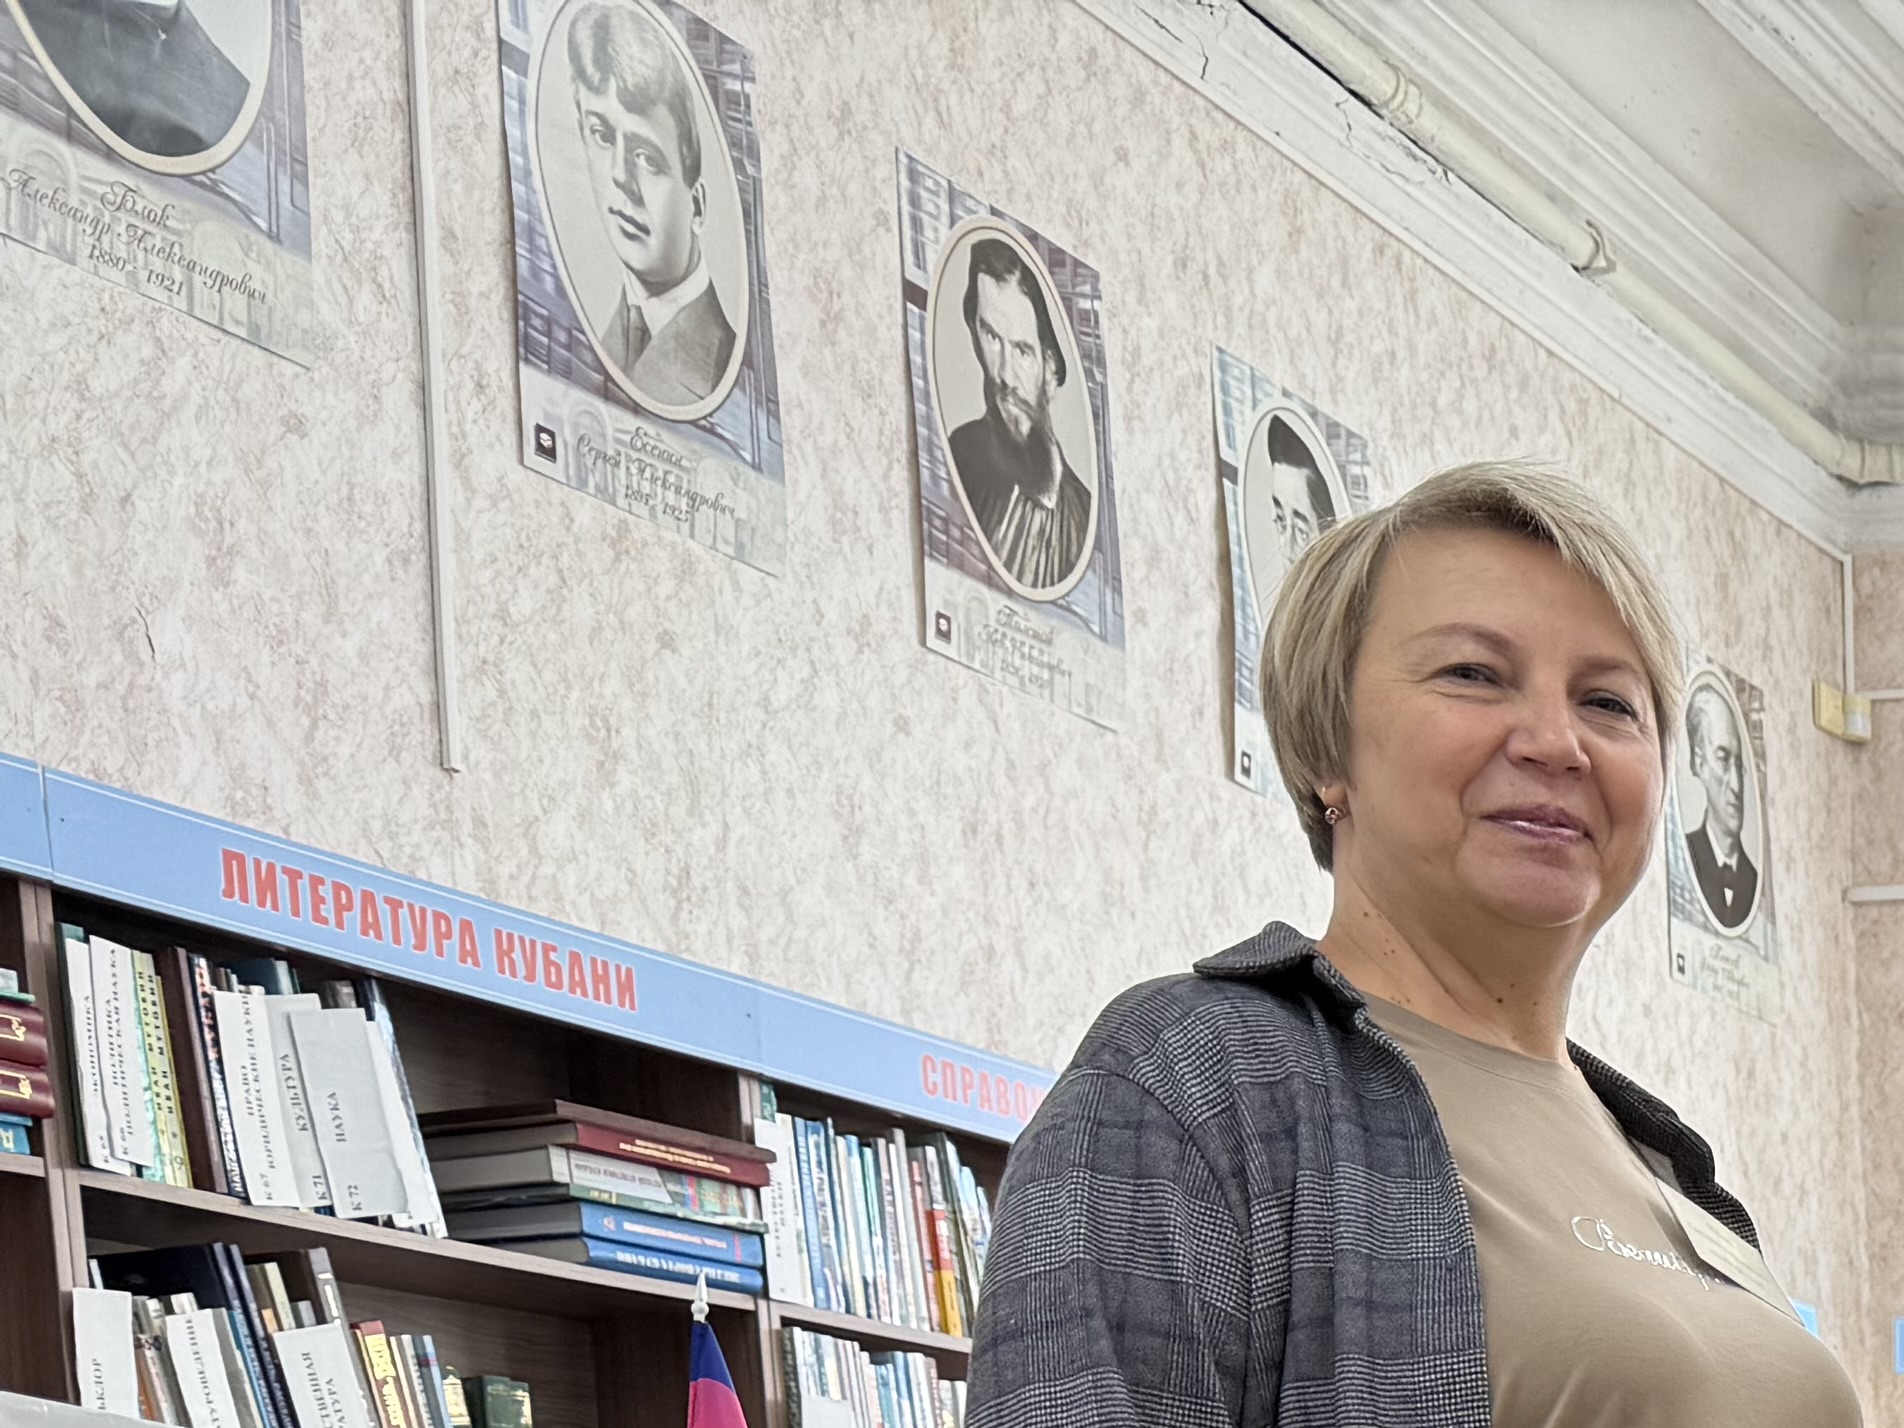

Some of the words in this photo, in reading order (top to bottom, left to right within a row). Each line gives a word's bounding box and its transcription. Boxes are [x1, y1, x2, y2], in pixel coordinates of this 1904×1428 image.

[8, 168, 111, 243] Александр
[117, 223, 267, 305] Александрович
[100, 180, 176, 228] Блок
[88, 244, 127, 272] 1880
[146, 269, 185, 296] 1921
[219, 846, 482, 971] ЛИТЕРАТУРА
[492, 925, 639, 1014] КУБАНИ
[279, 1053, 309, 1133] КУЛЬТУРА
[326, 1091, 347, 1143] НАУКА
